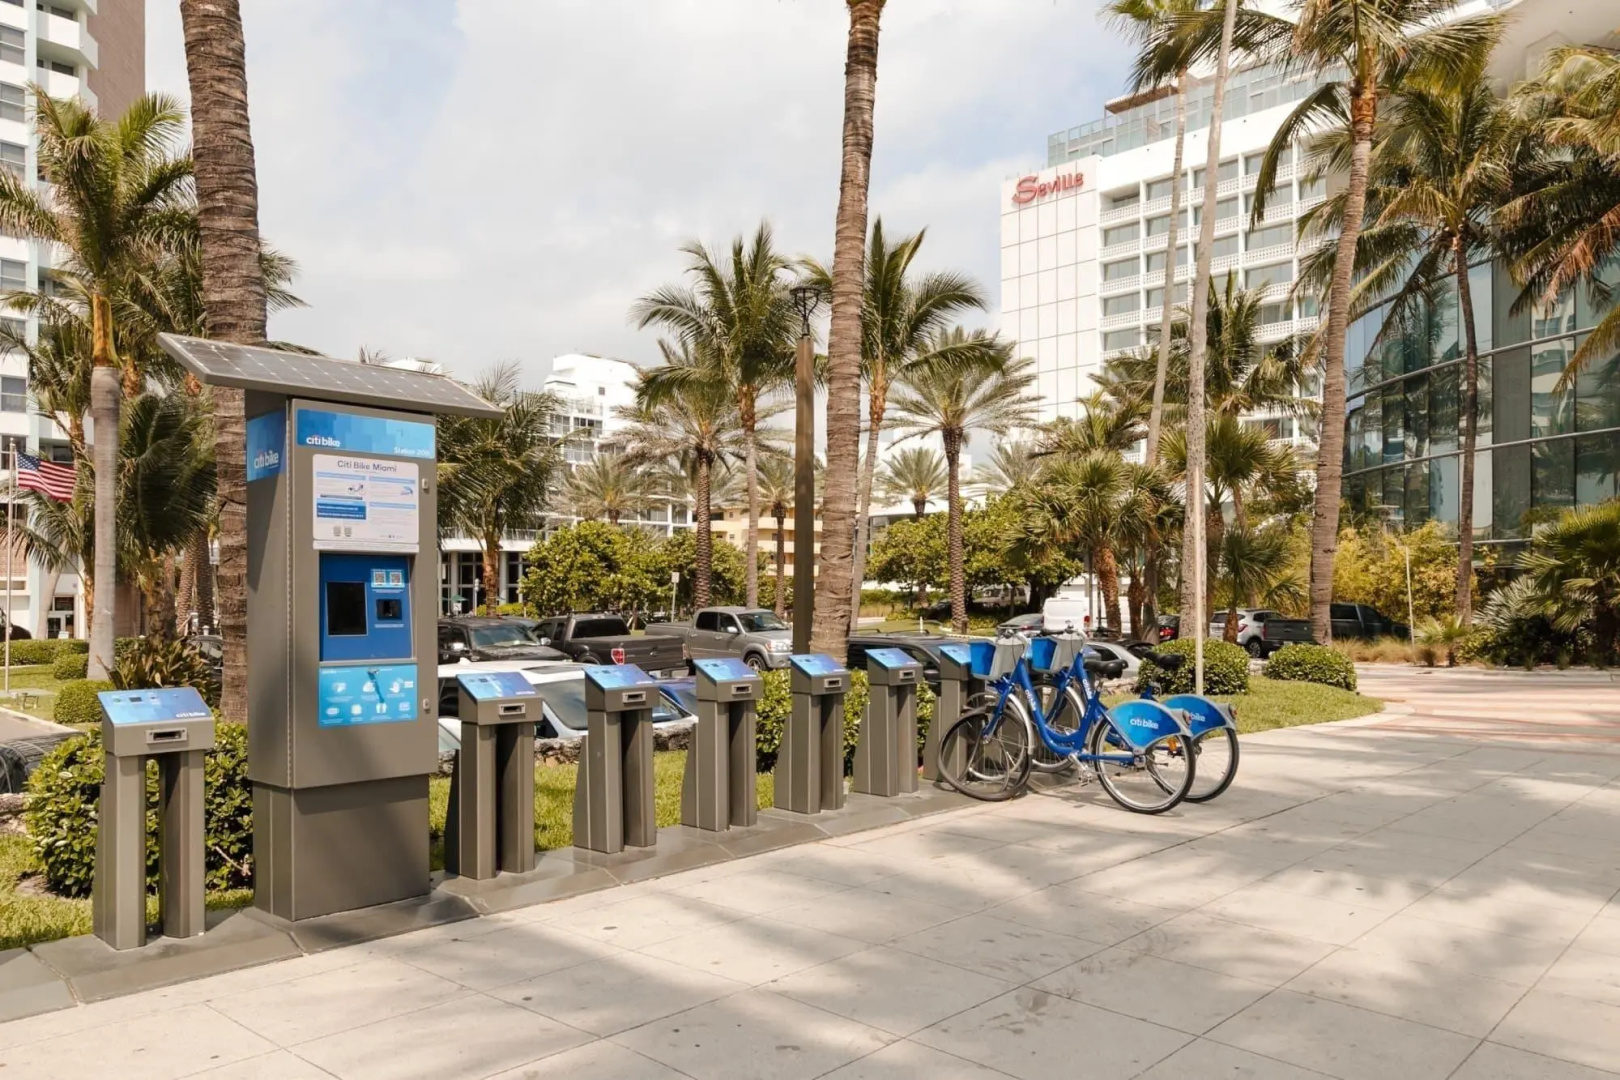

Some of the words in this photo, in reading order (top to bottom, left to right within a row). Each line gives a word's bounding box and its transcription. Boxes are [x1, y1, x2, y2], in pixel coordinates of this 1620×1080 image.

[1012, 172, 1084, 204] Seville
[337, 460, 352, 469] Citi
[353, 461, 370, 470] Bike
[372, 463, 397, 472] Miami
[1130, 717, 1143, 727] citi
[1142, 718, 1159, 729] bike
